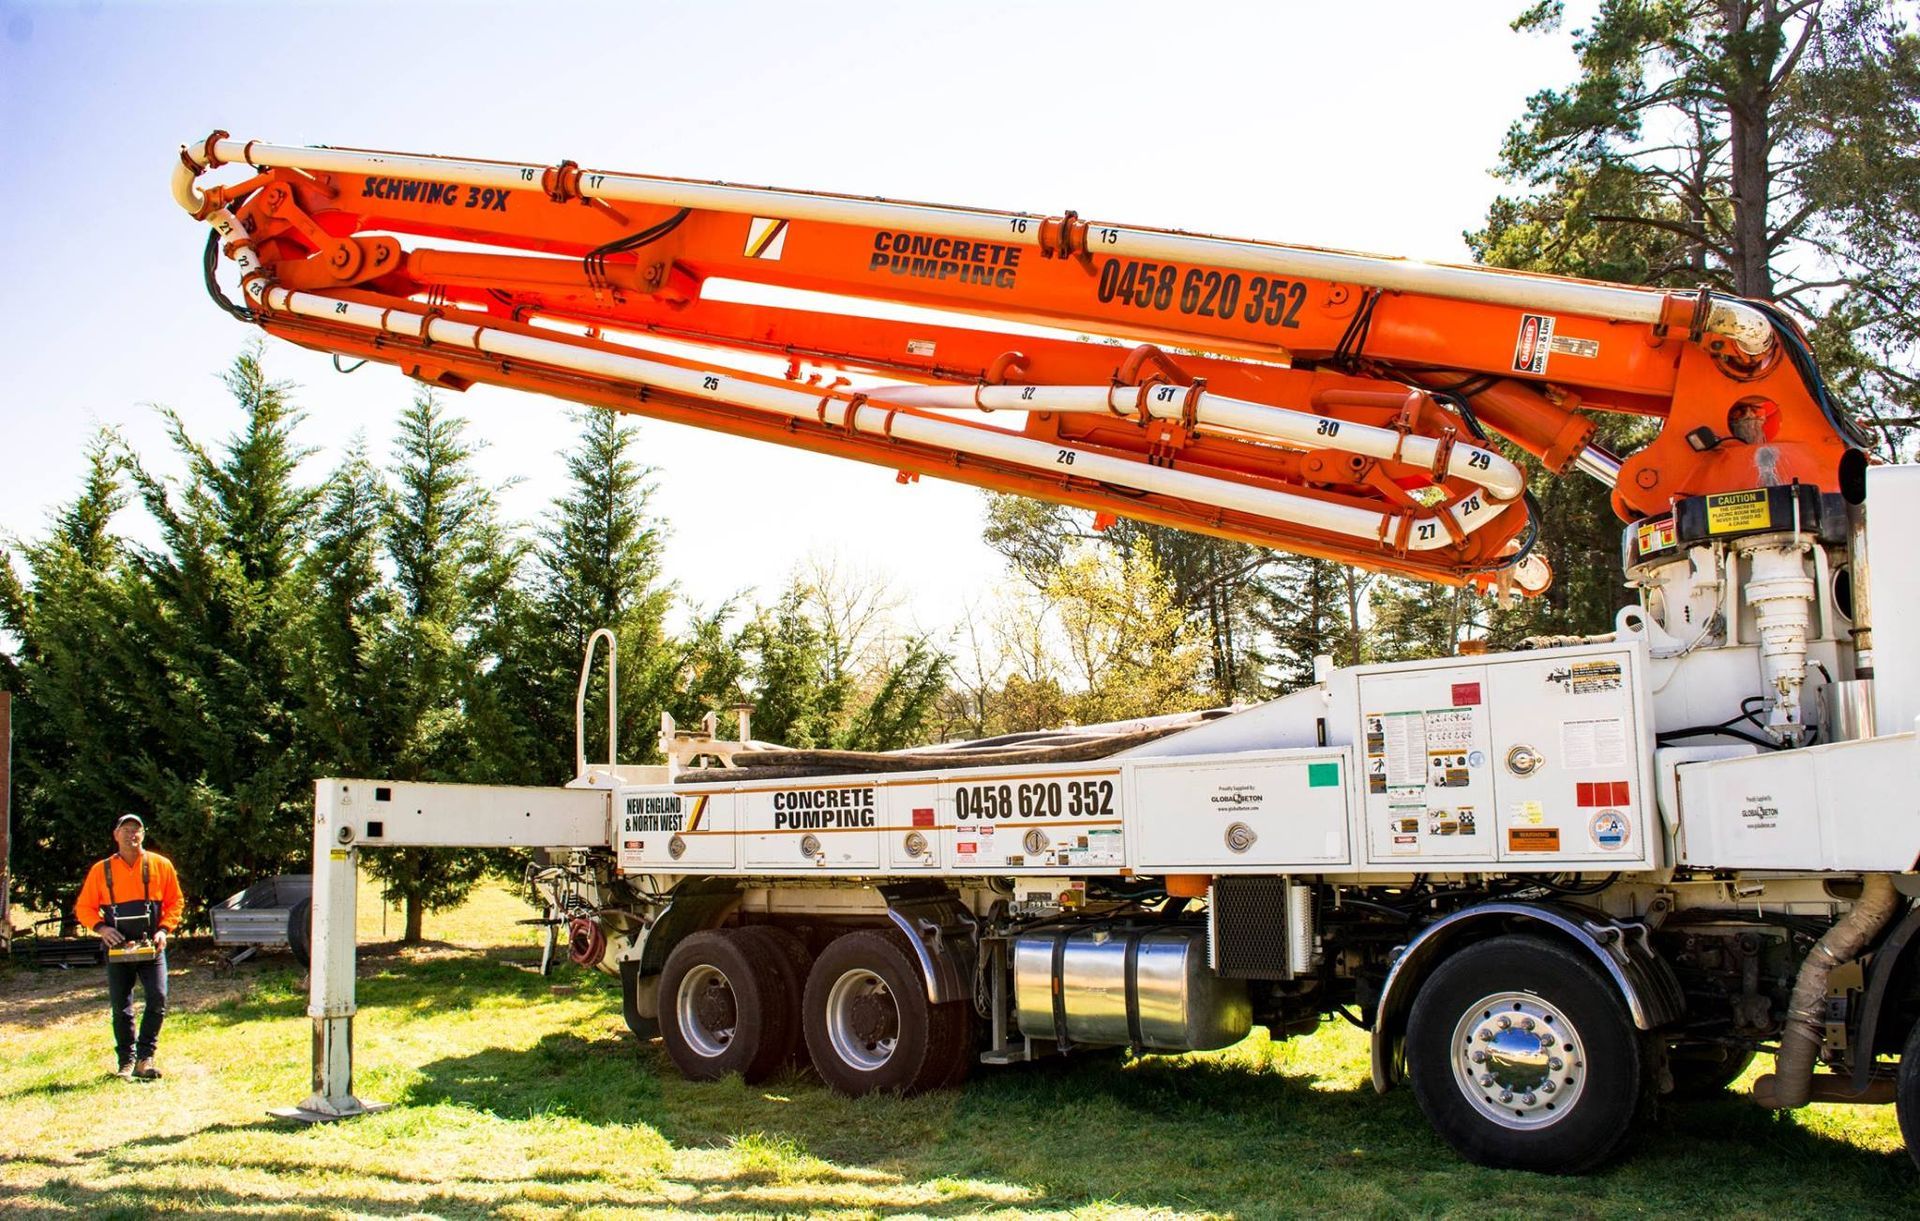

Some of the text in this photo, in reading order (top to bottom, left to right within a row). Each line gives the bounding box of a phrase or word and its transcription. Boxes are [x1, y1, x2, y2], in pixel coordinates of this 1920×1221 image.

[520, 168, 534, 181] 18
[590, 175, 604, 189] 17
[362, 177, 512, 212] SCHWING 39X
[219, 221, 234, 236] 21
[1010, 218, 1027, 234] 16
[1100, 229, 1118, 244] 15
[874, 231, 1022, 268] CONCRETE
[869, 253, 1017, 289] PUMPING
[250, 282, 262, 296] 23
[1098, 258, 1307, 329] 0458 620 352
[336, 302, 349, 314] 24
[1522, 325, 1535, 362] DANGER
[703, 376, 719, 391] 25
[1021, 387, 1036, 400] 32
[1157, 387, 1177, 402] 31
[1317, 419, 1340, 438] 30
[1056, 450, 1076, 465] 26
[1468, 451, 1491, 471] 29
[1461, 496, 1480, 516] 28
[1718, 493, 1756, 505] CAUTION
[1418, 524, 1435, 540] 27
[627, 797, 681, 814] NEW ENGLAND
[774, 788, 874, 810] CONCRETE
[955, 780, 1114, 820] 0458 620 352
[625, 814, 683, 832] & NORTH WEST
[774, 808, 875, 829] PUMPING
